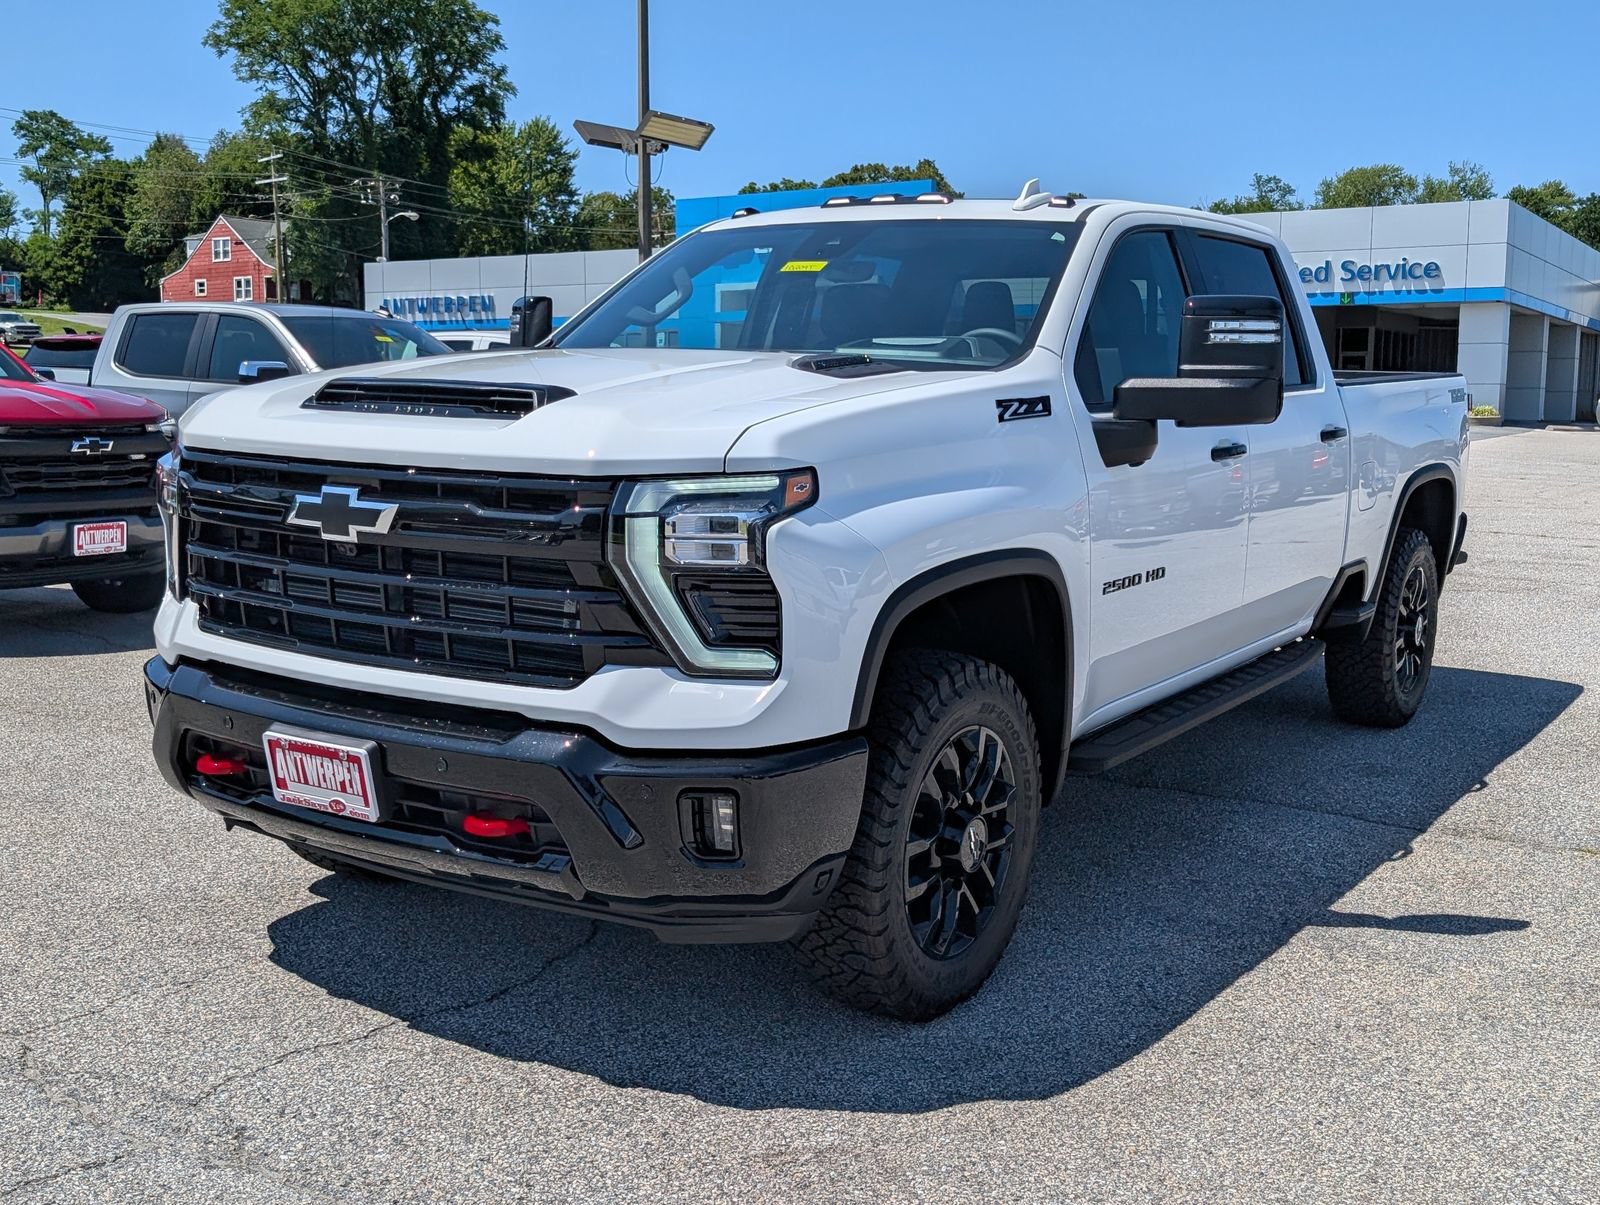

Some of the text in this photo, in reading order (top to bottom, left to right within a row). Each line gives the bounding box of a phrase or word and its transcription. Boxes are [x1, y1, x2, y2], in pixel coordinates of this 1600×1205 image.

[1340, 257, 1441, 282] Service
[79, 528, 122, 545] ANTWERPEN
[1102, 566, 1166, 595] 2500 HD
[275, 747, 364, 797] ANTWERPEN
